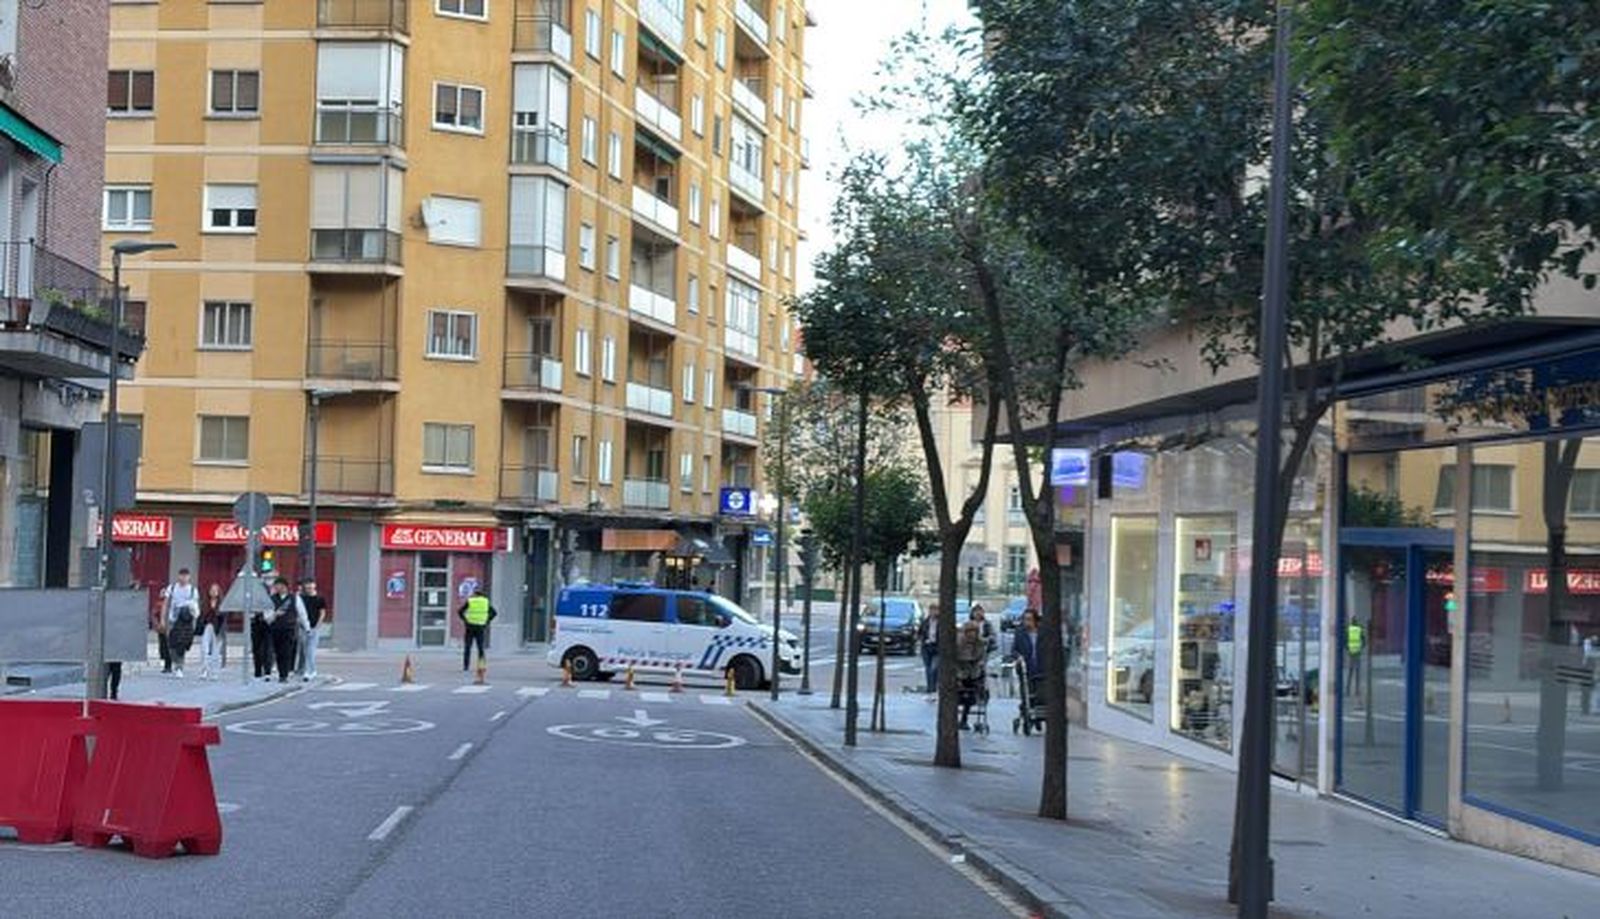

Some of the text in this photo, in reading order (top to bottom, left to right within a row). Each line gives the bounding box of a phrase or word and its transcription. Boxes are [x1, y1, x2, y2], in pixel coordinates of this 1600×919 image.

[97, 519, 166, 537] NERALI
[411, 527, 487, 545] GENERALI
[580, 603, 609, 618] 112
